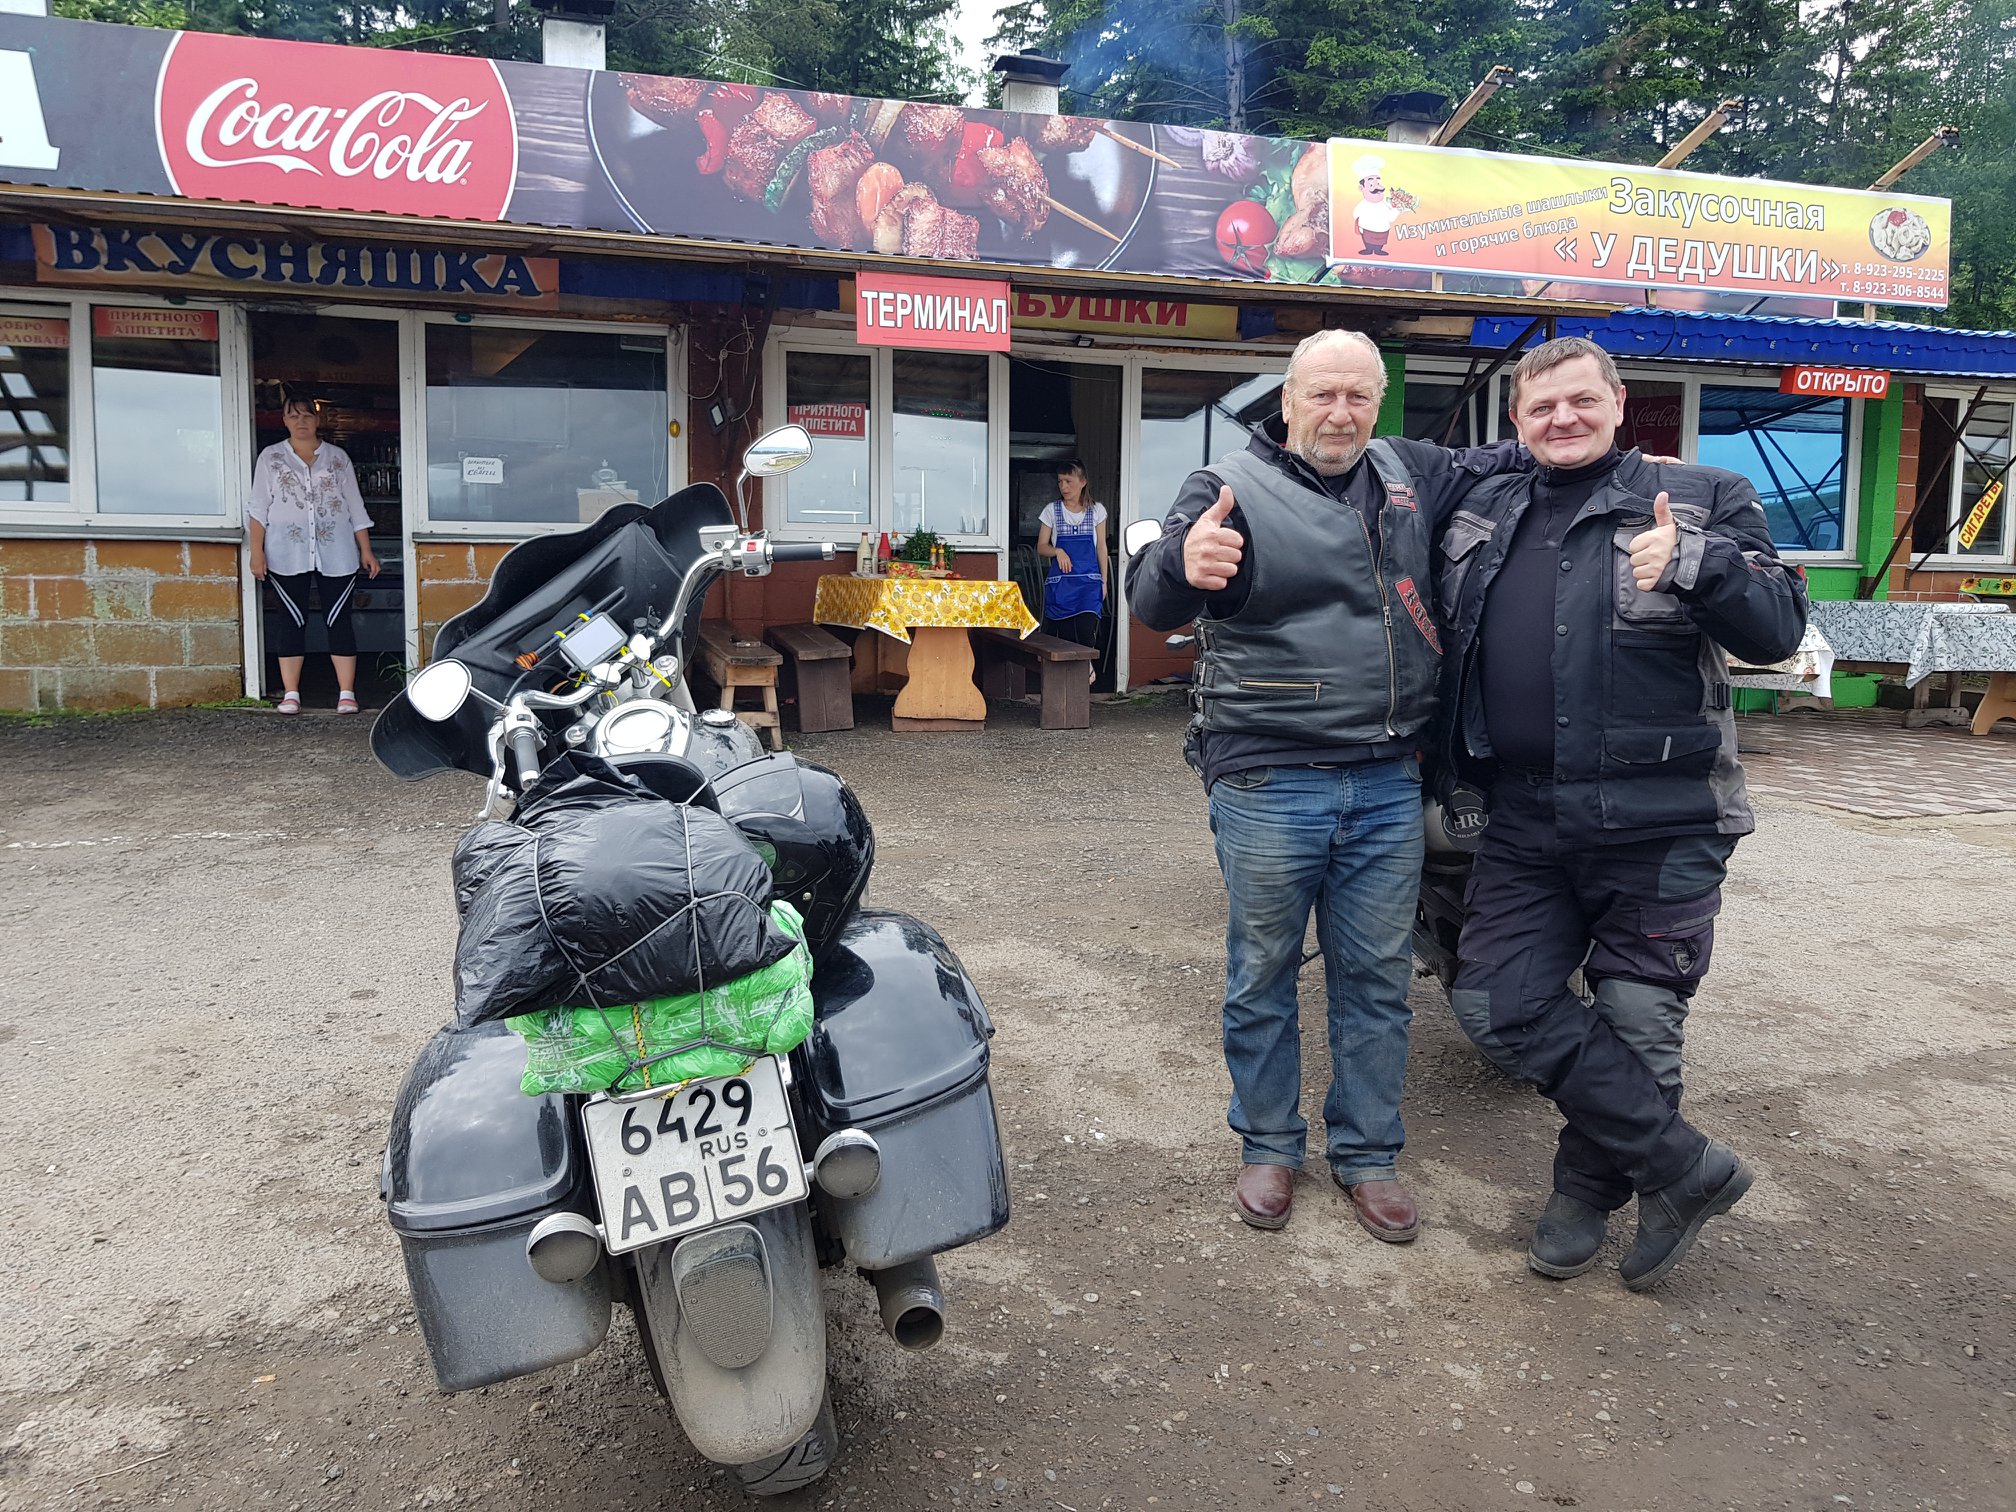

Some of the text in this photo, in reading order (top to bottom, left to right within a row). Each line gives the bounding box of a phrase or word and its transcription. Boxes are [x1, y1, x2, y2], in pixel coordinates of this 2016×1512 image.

[186, 77, 489, 184] Coca-Cola
[1395, 186, 1608, 241] Изумительные шашлыки
[1609, 177, 1825, 231] Закусочная
[1435, 216, 1578, 257] и горячие блюда
[50, 224, 542, 297] ВКУСНЯШКА
[1591, 231, 1617, 268] У
[1626, 235, 1840, 285] ДЕДУШКИ»
[1841, 263, 1945, 282] т. 8-923-295-2225
[1010, 291, 1187, 327] БУШКИ
[1840, 281, 1945, 299] т. 8-923-306-8544
[0, 320, 43, 331] ОБРО
[109, 310, 203, 323] ПРИЯТНОГО
[861, 290, 1008, 334] ТЕРМИНАЛ
[1797, 371, 1886, 394] ОТКРЫТО
[794, 404, 862, 418] ПРИЯТНОГО
[799, 418, 857, 432] АППЕТИТА
[1961, 483, 2001, 544] СИГАРЕТЫ
[620, 1077, 754, 1156] 6429
[699, 1131, 748, 1160] RUS
[621, 1145, 789, 1240] AB 56
